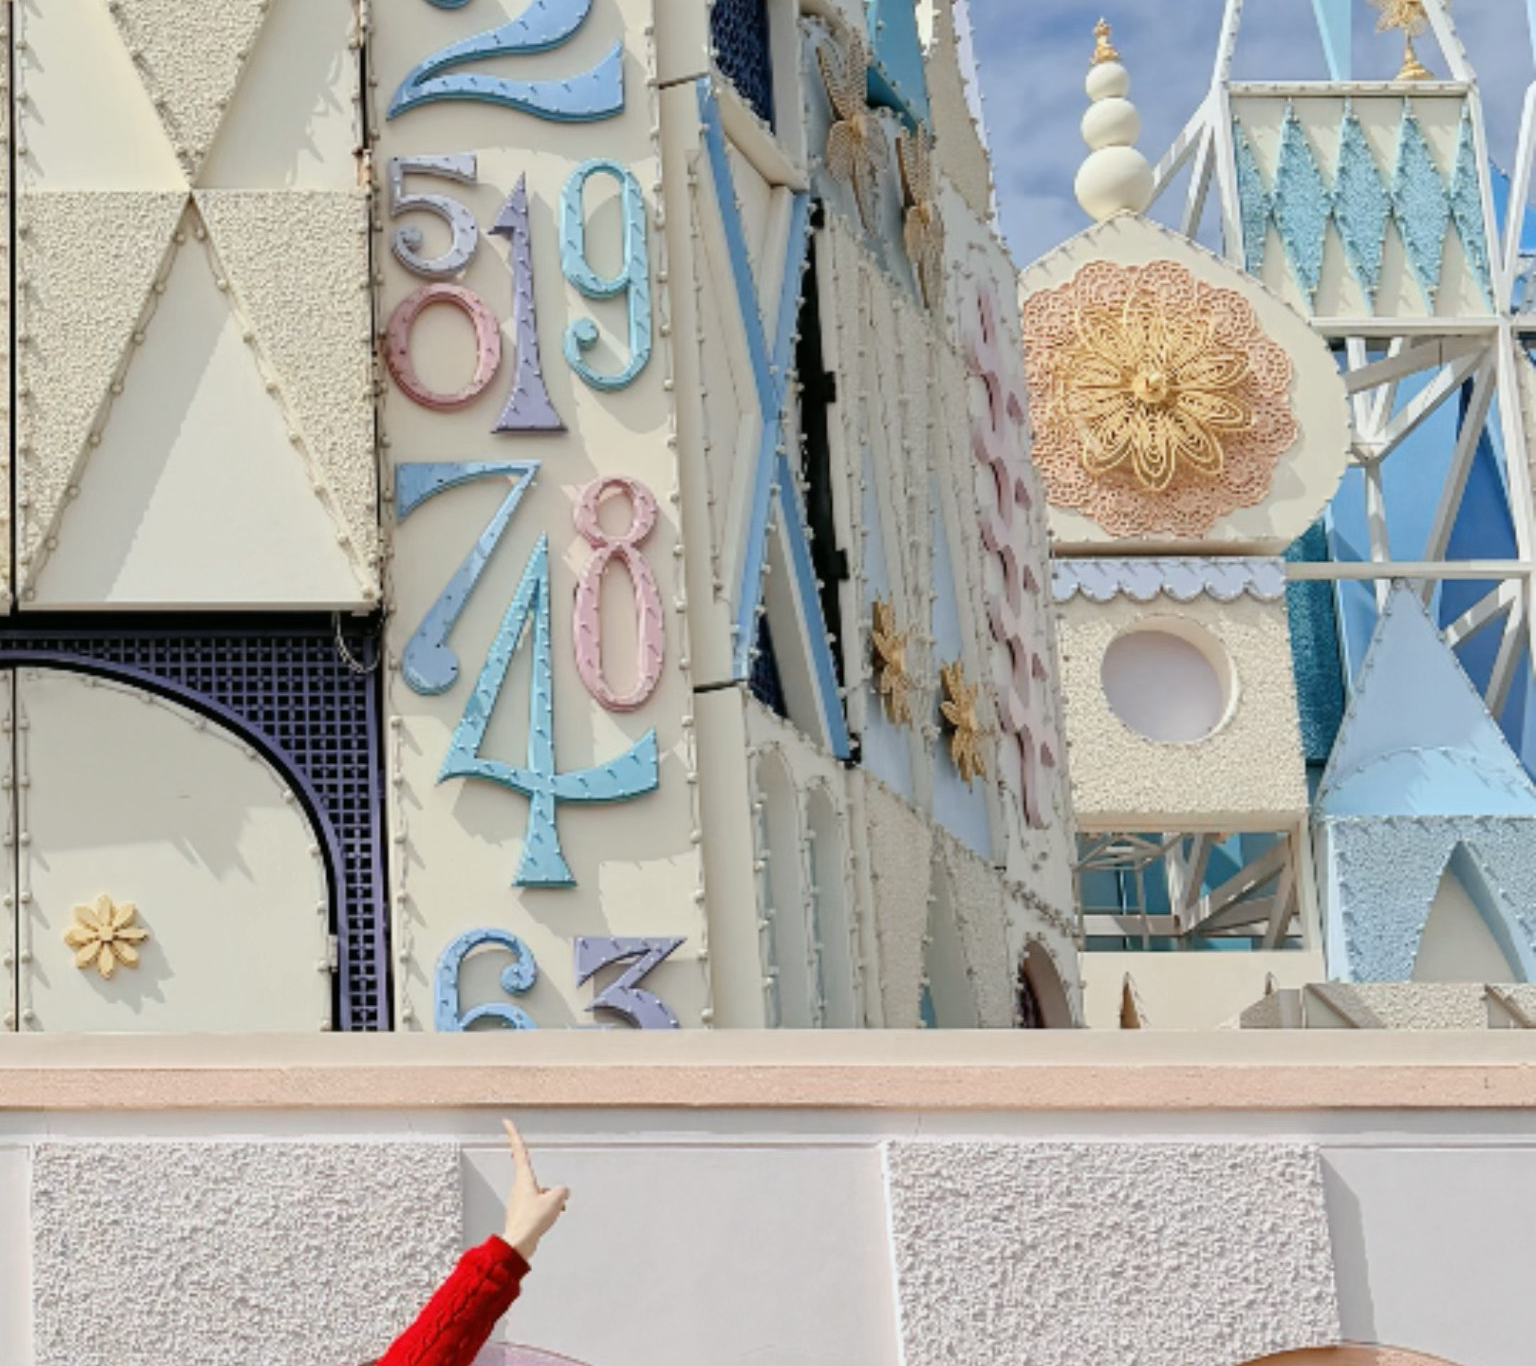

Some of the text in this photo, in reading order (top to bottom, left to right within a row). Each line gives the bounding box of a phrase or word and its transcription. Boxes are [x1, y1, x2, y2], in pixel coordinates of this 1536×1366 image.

[388, 153, 479, 279] 5
[488, 171, 569, 434] 1
[560, 157, 652, 392] 9
[395, 459, 542, 696] 7
[573, 475, 664, 713] 8
[435, 531, 660, 888] 4
